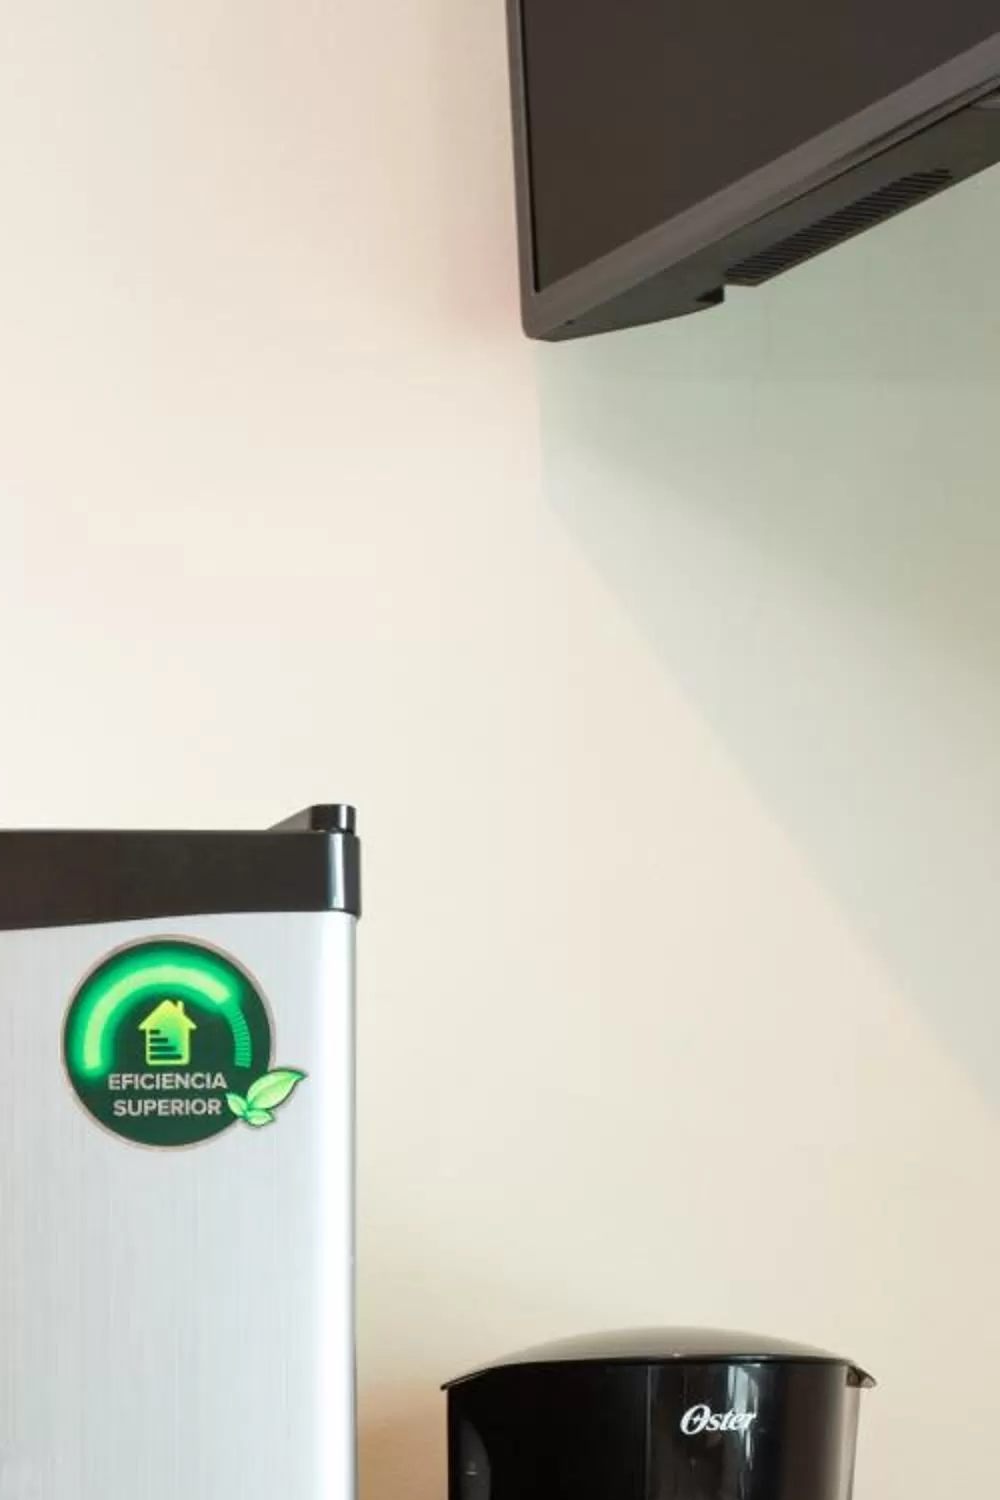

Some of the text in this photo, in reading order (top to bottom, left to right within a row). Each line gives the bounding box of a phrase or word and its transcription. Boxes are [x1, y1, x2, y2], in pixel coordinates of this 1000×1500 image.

[108, 1072, 228, 1090] EFICIENCIA
[113, 1098, 222, 1116] SUPERIOR
[680, 1403, 757, 1435] Oster
